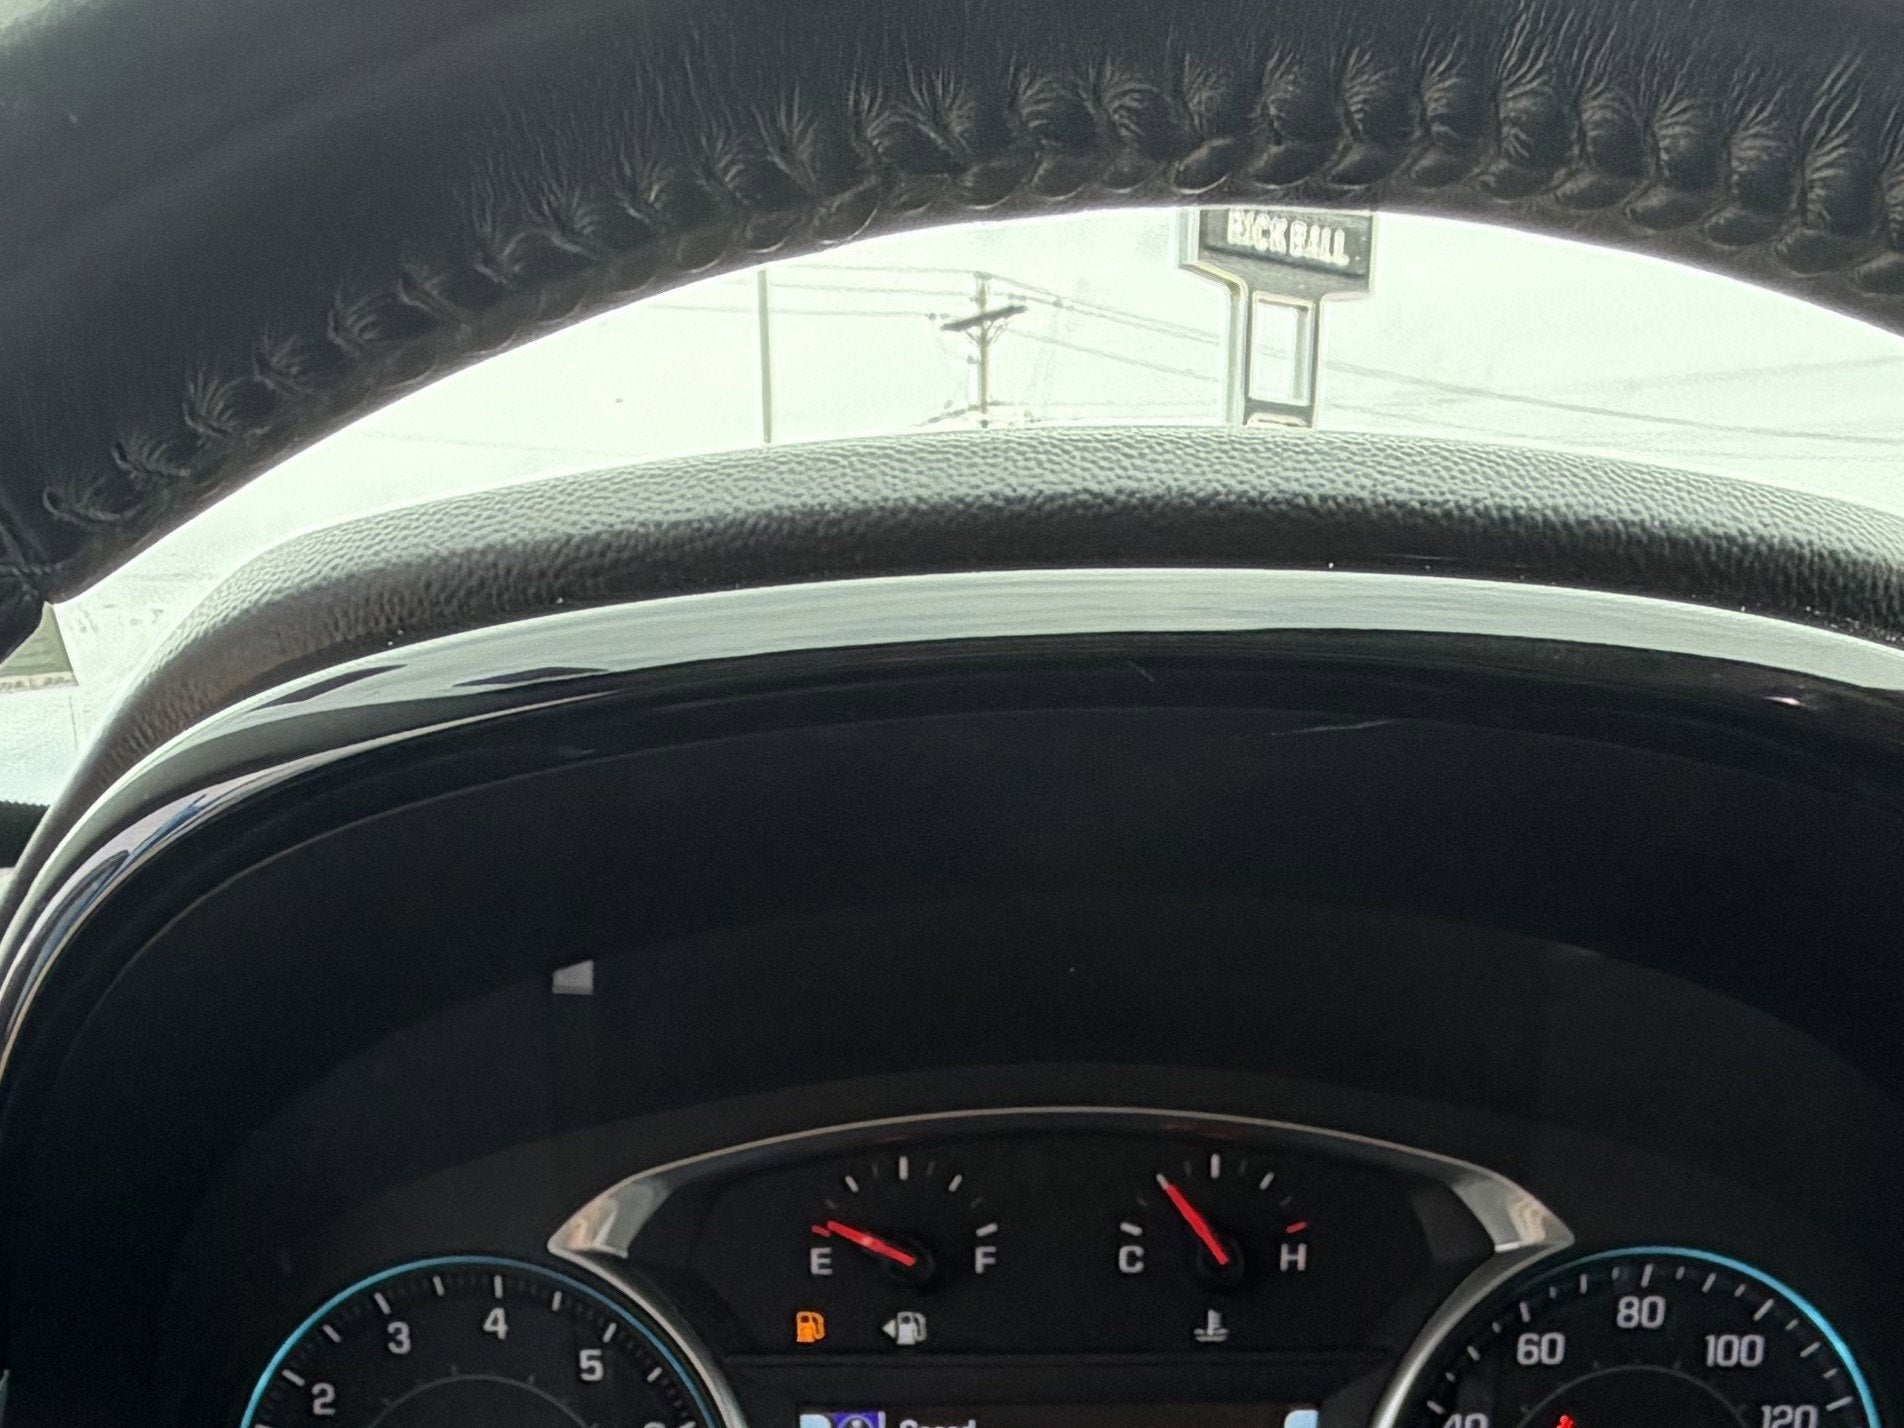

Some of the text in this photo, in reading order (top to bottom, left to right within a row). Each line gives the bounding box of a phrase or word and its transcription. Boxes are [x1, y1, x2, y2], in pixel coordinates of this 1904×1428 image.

[1227, 209, 1351, 266] RICK BALL
[810, 1247, 833, 1275] E
[975, 1246, 997, 1273] F
[1119, 1246, 1144, 1273] C
[1280, 1243, 1307, 1272] H
[483, 1307, 508, 1340] 4
[1616, 1296, 1666, 1329] 80
[388, 1322, 411, 1354] 3
[1517, 1332, 1565, 1365] 60
[1705, 1334, 1765, 1367] 100
[580, 1349, 603, 1381] 5
[311, 1382, 336, 1415] 2
